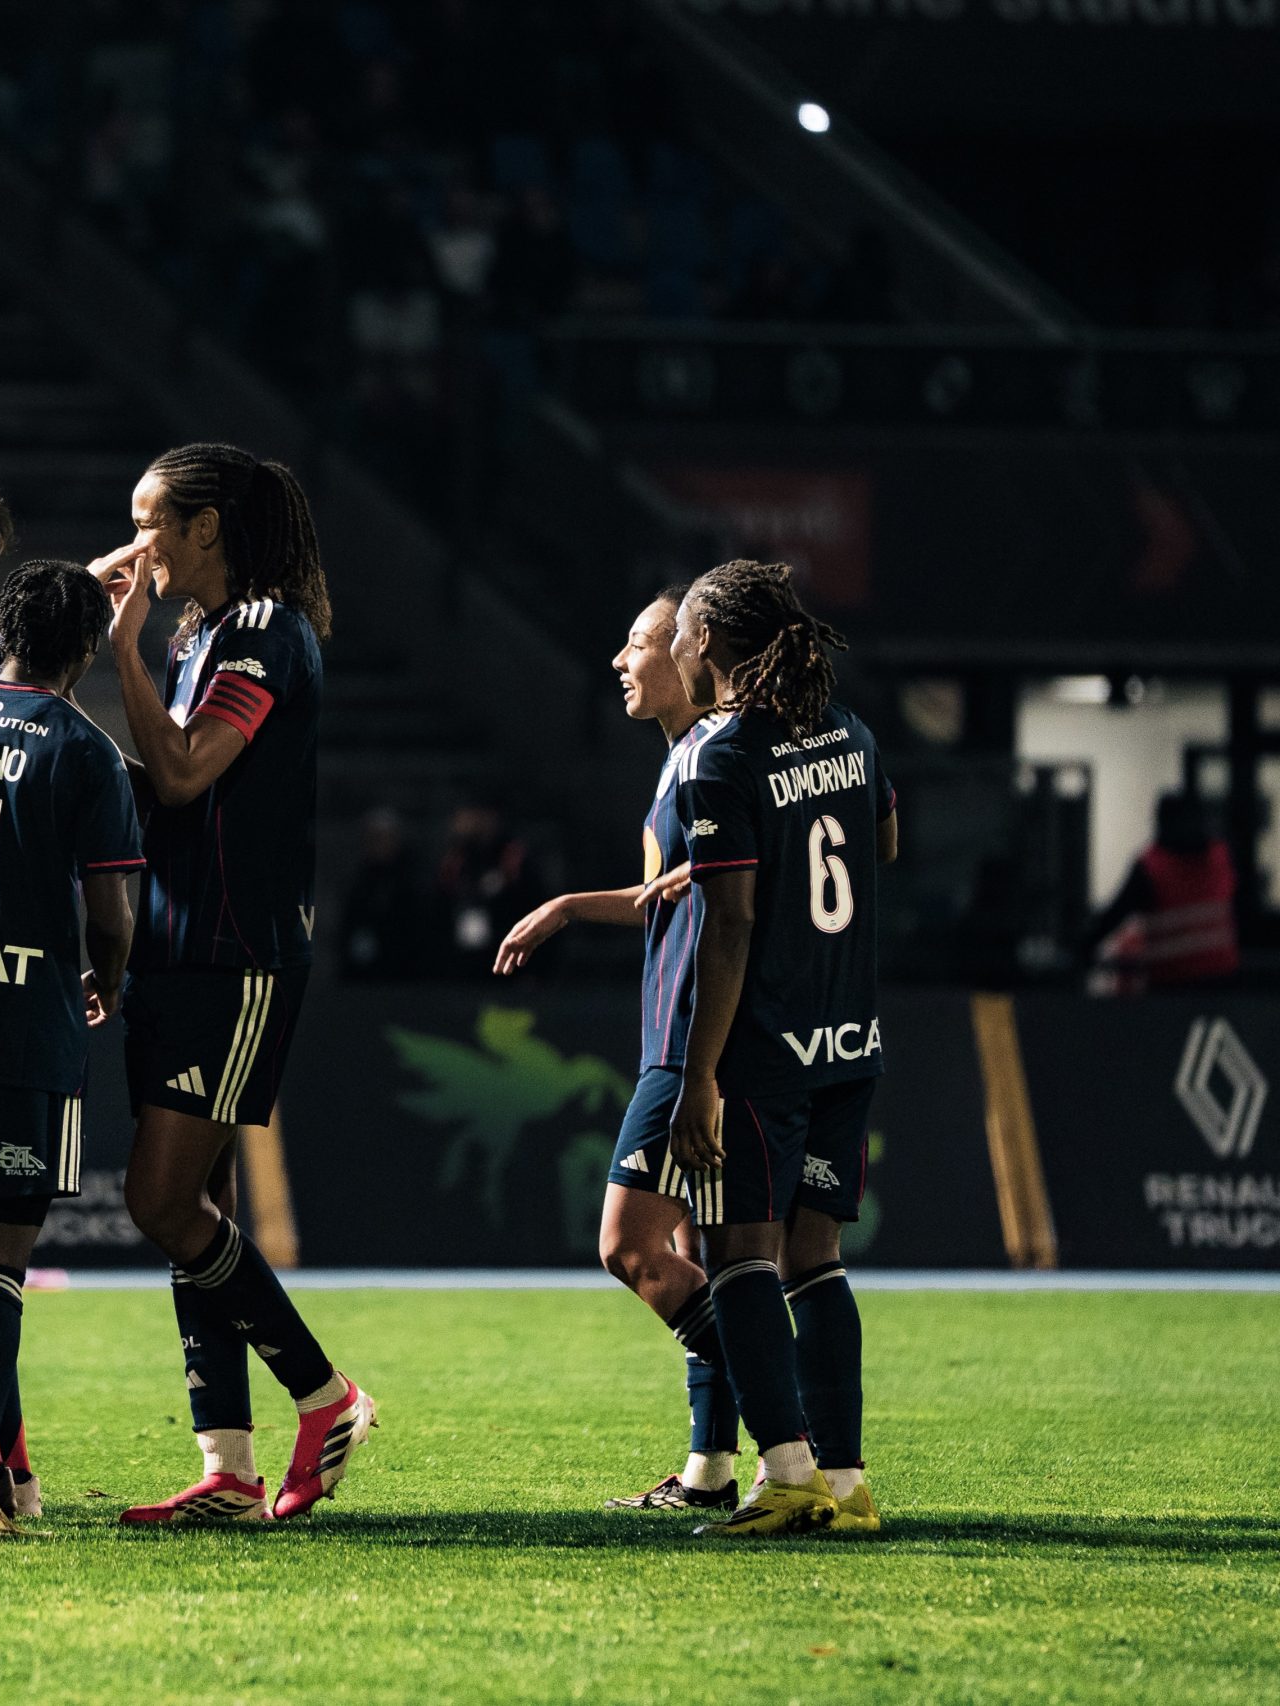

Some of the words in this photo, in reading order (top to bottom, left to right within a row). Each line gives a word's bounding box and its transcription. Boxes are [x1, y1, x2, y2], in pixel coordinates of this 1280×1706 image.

[771, 727, 850, 759] DATAOLUTION
[768, 750, 868, 809] DUMORNAY
[808, 814, 855, 935] 6
[781, 1016, 884, 1067] VICA
